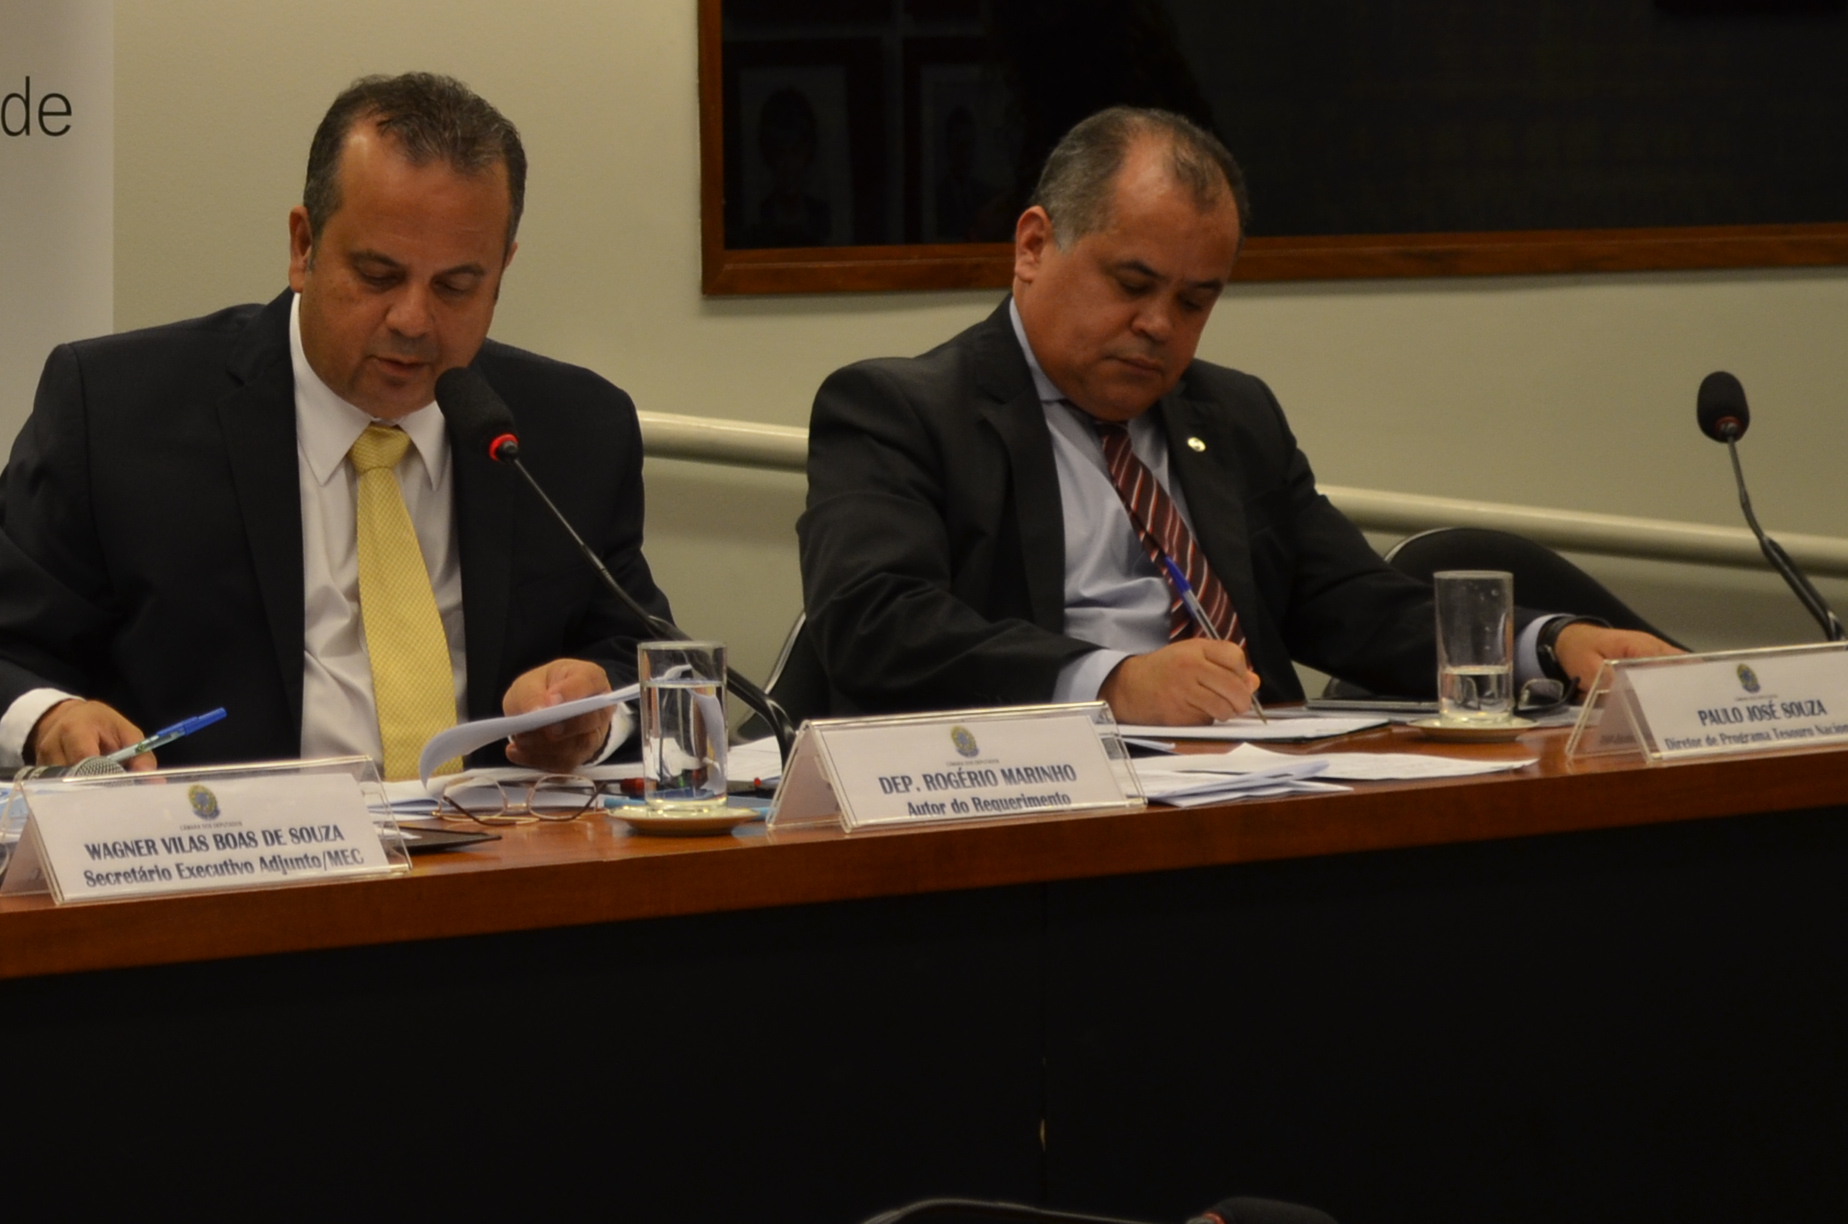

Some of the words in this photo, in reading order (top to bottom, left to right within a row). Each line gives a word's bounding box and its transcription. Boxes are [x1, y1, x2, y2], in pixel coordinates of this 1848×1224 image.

[0, 75, 73, 137] de
[1697, 706, 1744, 726] PAULO
[1746, 700, 1781, 723] JOSÉ
[1780, 699, 1828, 719] SOUZA
[1664, 736, 1702, 751] Diretor
[1705, 734, 1717, 746] de
[1719, 730, 1772, 745] Programa
[1772, 726, 1814, 740] Tesouro
[878, 777, 921, 796] DEP.
[923, 766, 998, 793] ROGÉRIO
[1000, 763, 1078, 787] MARINHO
[906, 797, 948, 818] Autor
[951, 796, 971, 815] do
[974, 791, 1072, 814] Requerimento
[84, 838, 159, 862] WAGNER
[160, 833, 210, 857] VILAS
[214, 829, 260, 853] BOAS
[262, 827, 287, 848] DE
[290, 823, 345, 846] SOUZA
[83, 865, 173, 888] Secretário
[176, 858, 255, 882] Executivo
[258, 847, 365, 876] Adjunto/MEC
